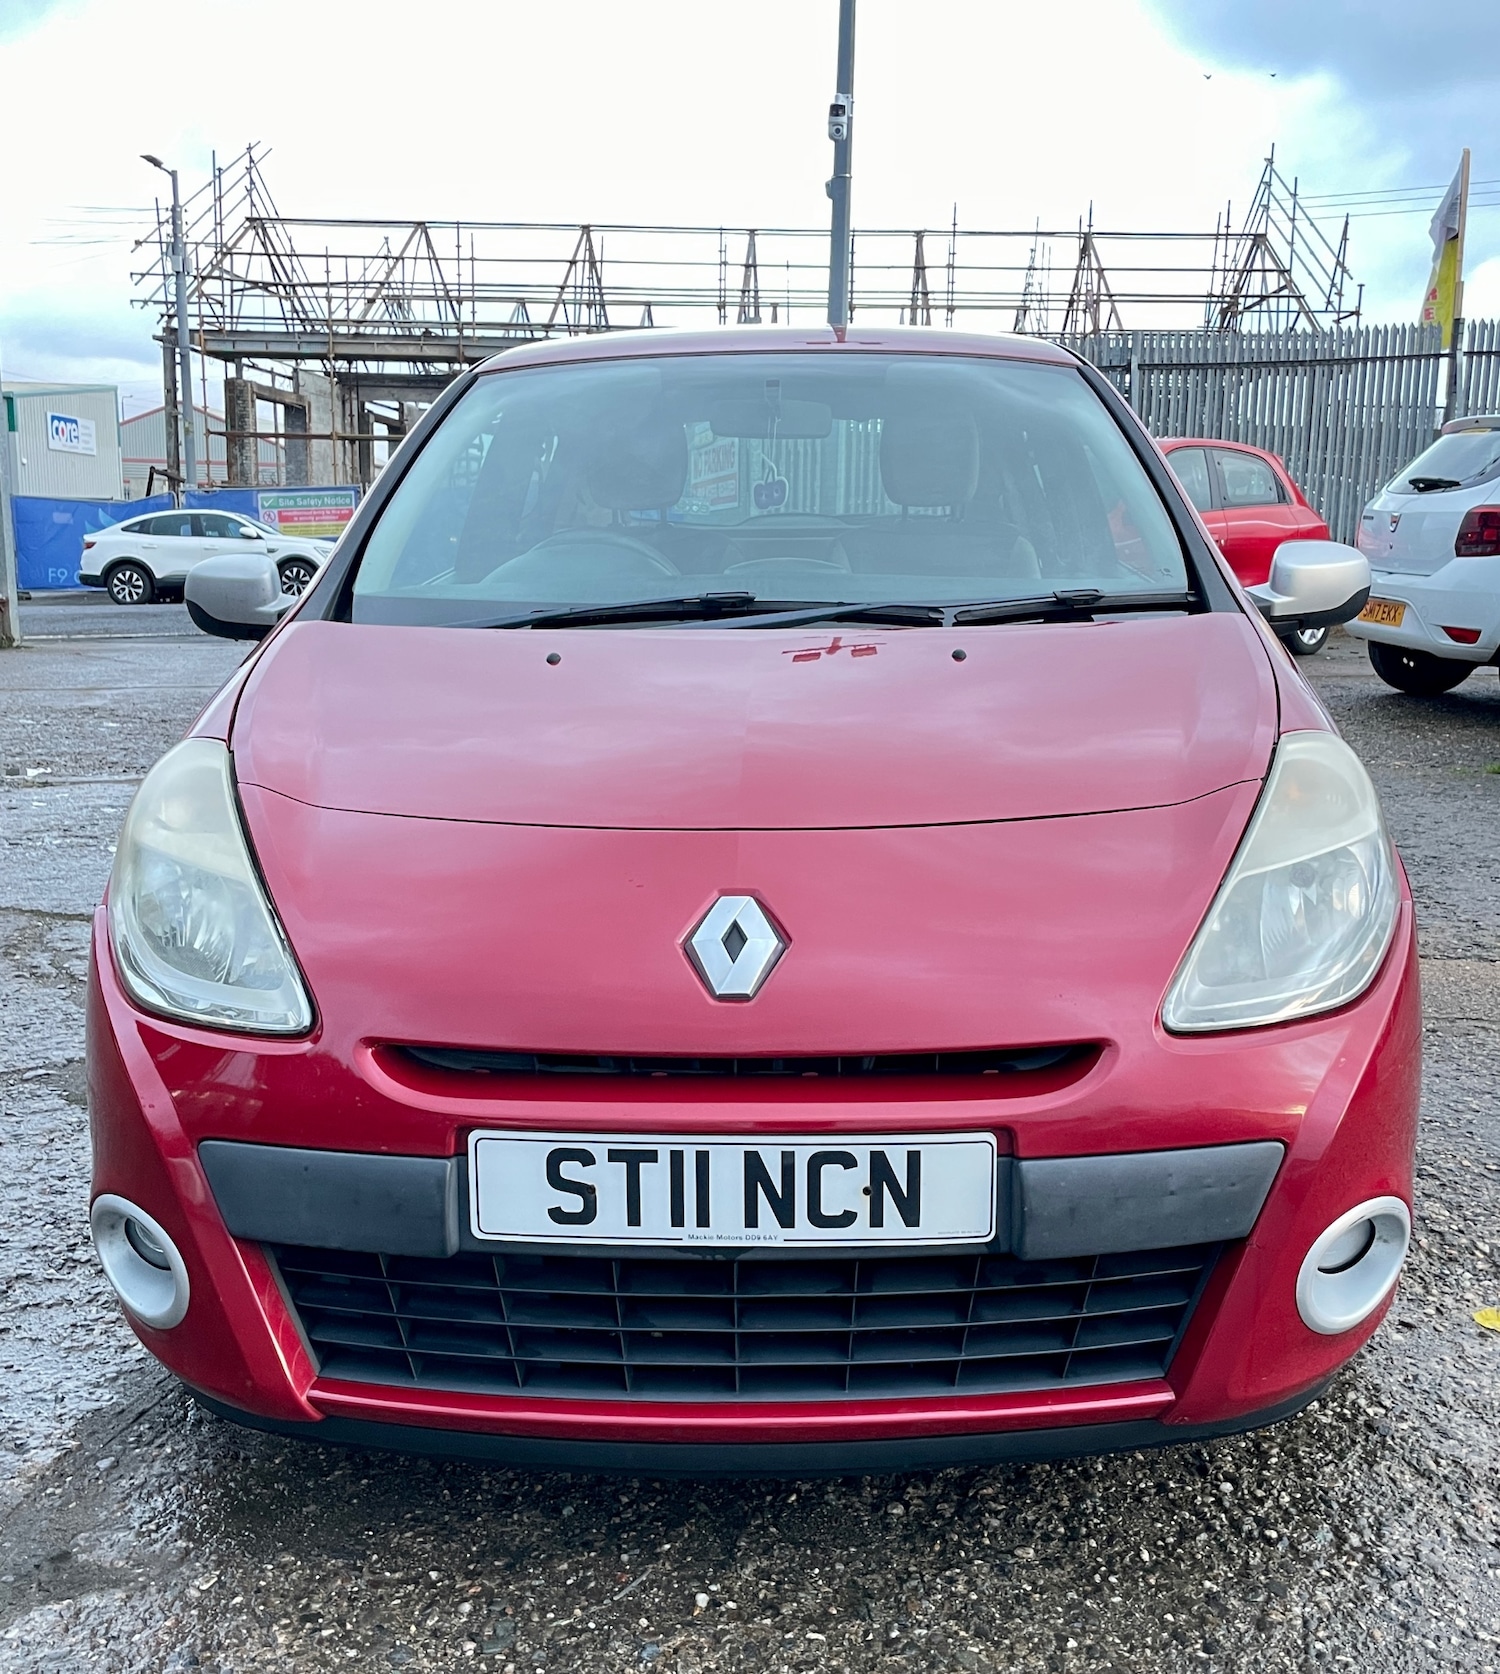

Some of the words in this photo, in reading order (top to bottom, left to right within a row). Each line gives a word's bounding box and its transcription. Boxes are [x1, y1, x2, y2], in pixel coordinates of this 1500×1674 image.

[52, 419, 79, 443] core
[703, 441, 735, 476] PARKING
[278, 498, 294, 506] Site
[296, 497, 322, 506] Safety
[324, 496, 350, 505] Notice
[48, 568, 67, 583] F9
[1381, 605, 1399, 622] EKX
[546, 1148, 710, 1228] ST11
[744, 1150, 921, 1228] NCN
